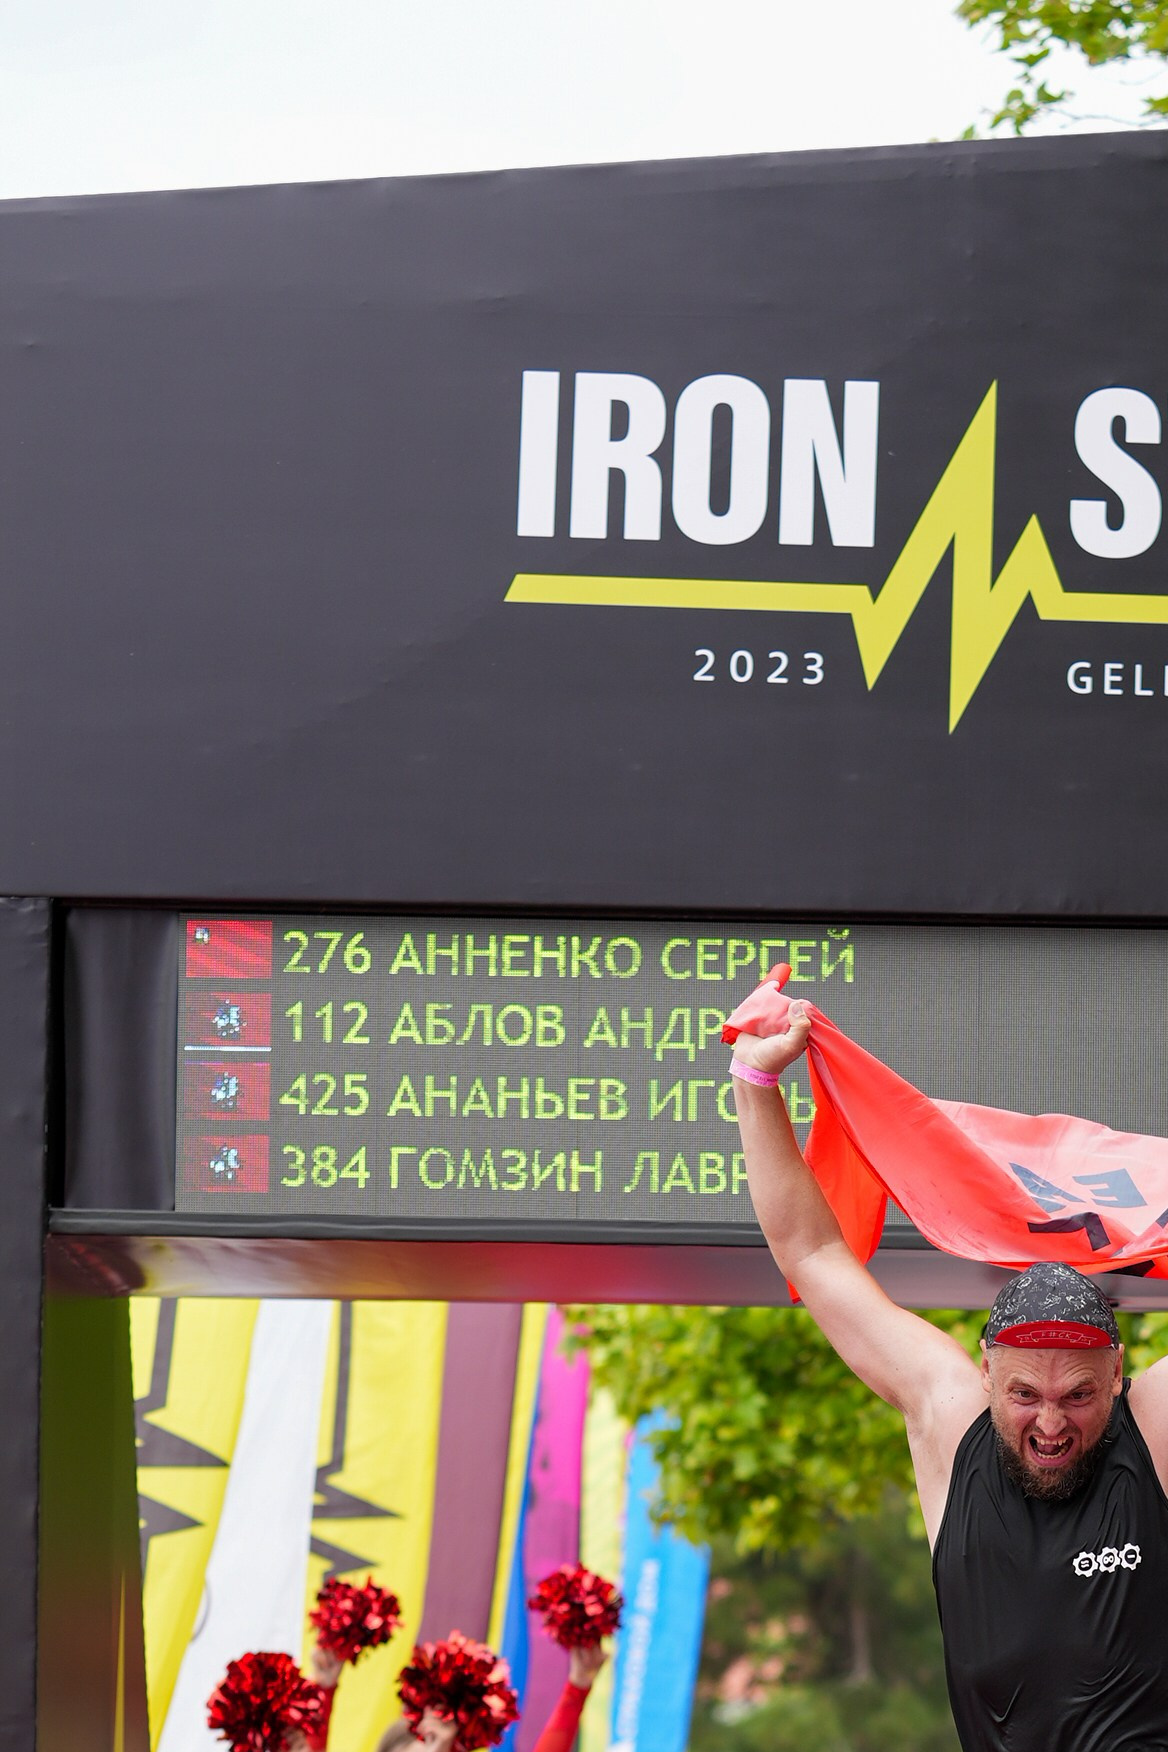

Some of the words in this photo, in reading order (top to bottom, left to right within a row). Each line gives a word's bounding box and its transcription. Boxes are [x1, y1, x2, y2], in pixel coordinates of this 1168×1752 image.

[517, 370, 880, 548] IRON
[693, 648, 825, 685] 2023
[282, 928, 372, 974] 276
[388, 931, 643, 978] АННЕНКО
[660, 927, 855, 983] СЕРГЕЙ
[284, 1000, 370, 1044] 112
[388, 1002, 566, 1047] АБЛОВ
[583, 1006, 736, 1062] АНДР
[278, 1071, 370, 1116] 425
[386, 1074, 629, 1121] АНАНЬЕВ
[648, 1078, 817, 1123] ИГОЬ
[281, 1143, 370, 1189] 384
[389, 1145, 604, 1192] ГОМЗИН
